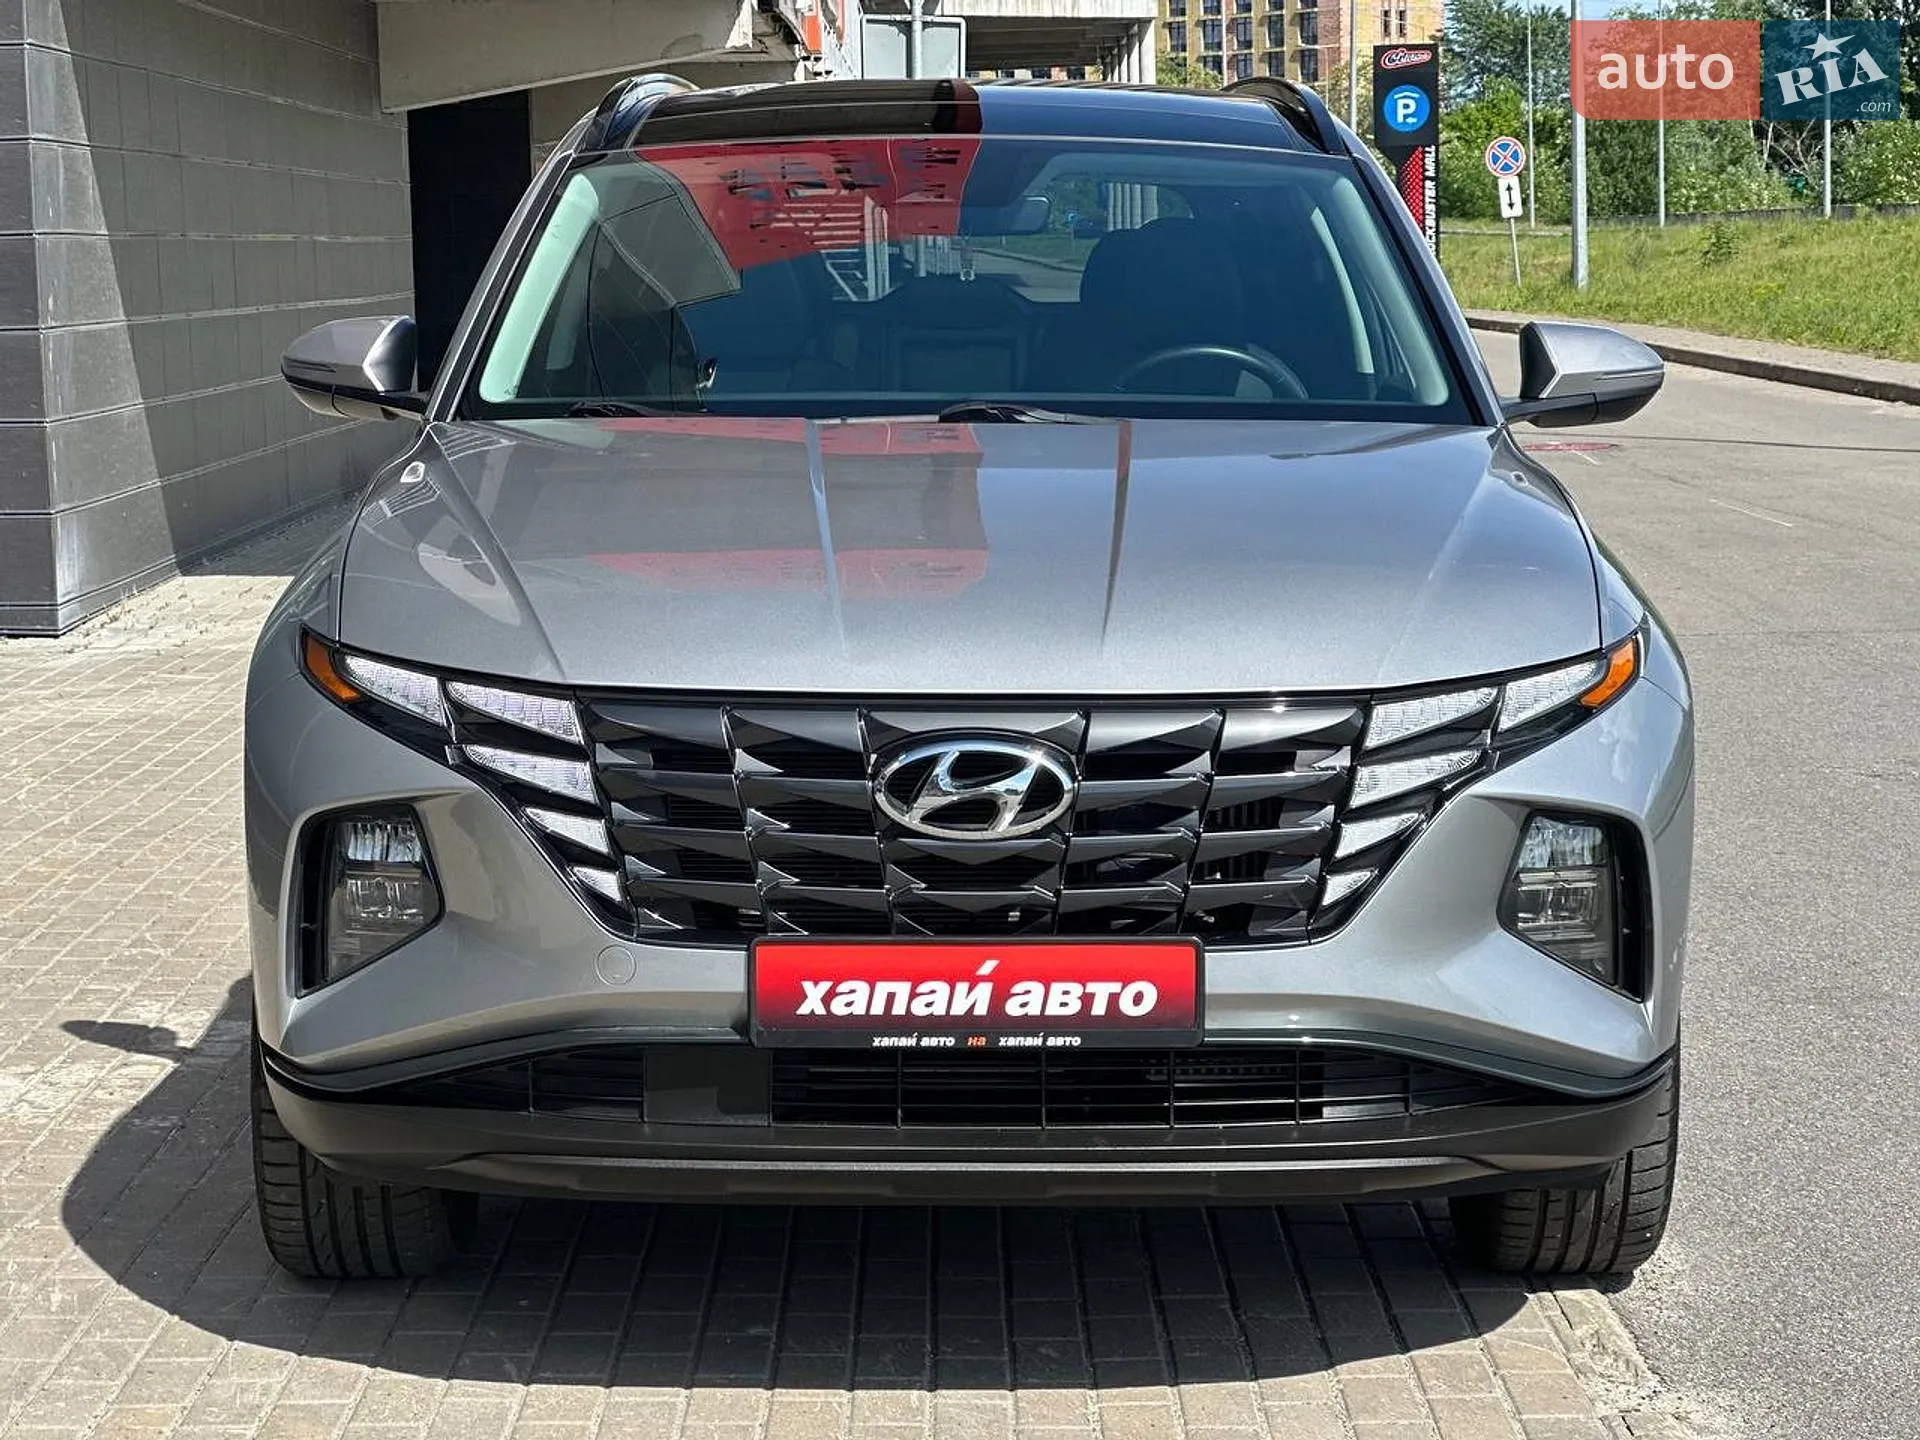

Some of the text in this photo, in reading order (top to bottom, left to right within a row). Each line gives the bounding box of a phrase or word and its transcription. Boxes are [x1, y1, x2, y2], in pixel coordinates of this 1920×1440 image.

[1396, 97, 1417, 124] P
[1424, 144, 1437, 255] OCKBUSTER MALL
[795, 959, 1159, 1017] хапай авто
[872, 1032, 1082, 1047] хапай авто на хапай авто
